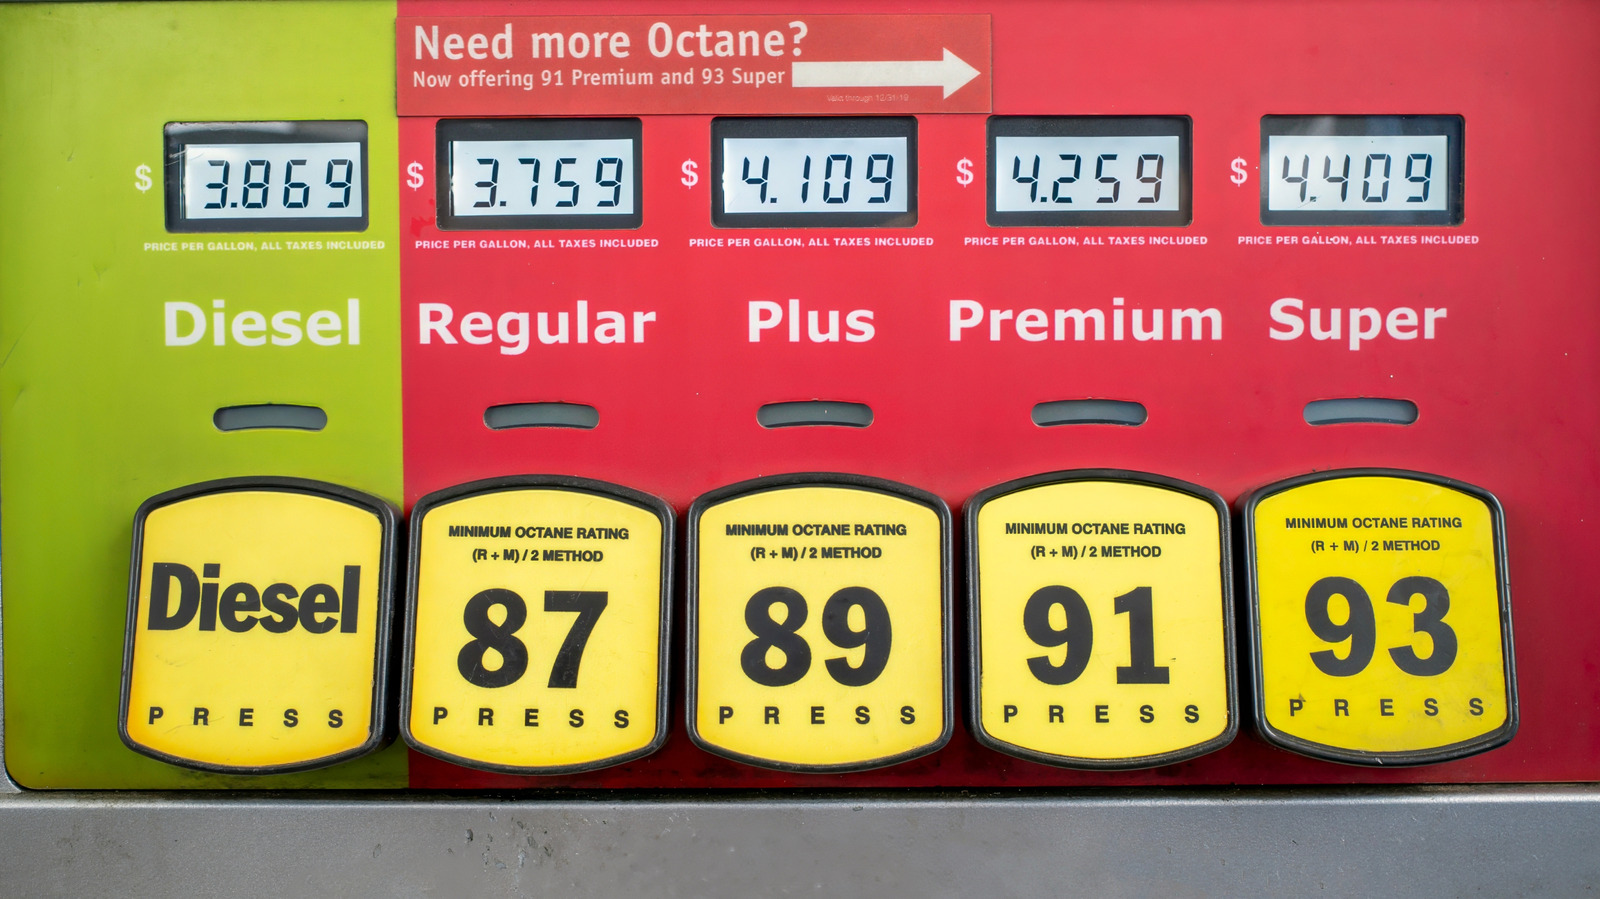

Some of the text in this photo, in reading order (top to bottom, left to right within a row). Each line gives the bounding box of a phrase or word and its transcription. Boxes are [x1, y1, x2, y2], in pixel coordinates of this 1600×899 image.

[414, 20, 808, 60] Need more Octane?
[413, 67, 785, 90] Now offering 91 Premium and 93 Super
[135, 164, 152, 193] $
[204, 159, 354, 209] 3.869
[407, 161, 424, 191] $
[472, 157, 623, 207] 3.759
[681, 159, 698, 189] $
[741, 154, 894, 204] 4.109
[957, 158, 973, 187] $
[1012, 154, 1164, 203] 4.259
[1230, 157, 1247, 186] $
[1281, 154, 1432, 203] 4.409
[143, 240, 386, 252] PRICE PER GALLON, ALL TAXES INCLUDED
[414, 238, 659, 250] PRICE PER GALLON, ALL TAXES INCLUDED
[688, 237, 934, 248] PRICE PER GALLON, ALL TAXES INCLUDED
[963, 235, 1208, 247] PRICE PER GALLON, ALL TAXES INCLUDED
[1237, 235, 1480, 247] PRICE PER GALLON, ALL TAXES INCLUDED
[164, 298, 360, 346] Diesel
[418, 299, 656, 354] Regular
[748, 298, 876, 343] Plus
[949, 297, 1222, 342] Premium
[1269, 297, 1447, 350] Super
[449, 526, 629, 540] MINIMUM OCTANE RATING
[726, 524, 906, 536] MINIMUM OCTANE RATING
[1006, 523, 1185, 534] MINIMUM OCTANE RATING
[1286, 517, 1462, 529] MINIMUM OCTANE RATING
[473, 549, 603, 563] (R + M) / 2 METHOD
[751, 547, 882, 561] (R + M) / 2 METHOD
[1031, 546, 1161, 560] (R + M) / 2 METHOD
[1311, 540, 1440, 553] (R + M) / 2 METHOD
[148, 562, 361, 634] Diesel
[457, 588, 609, 688] 87
[740, 586, 892, 687] 89
[1022, 585, 1170, 685] 91
[1305, 576, 1458, 677] 93
